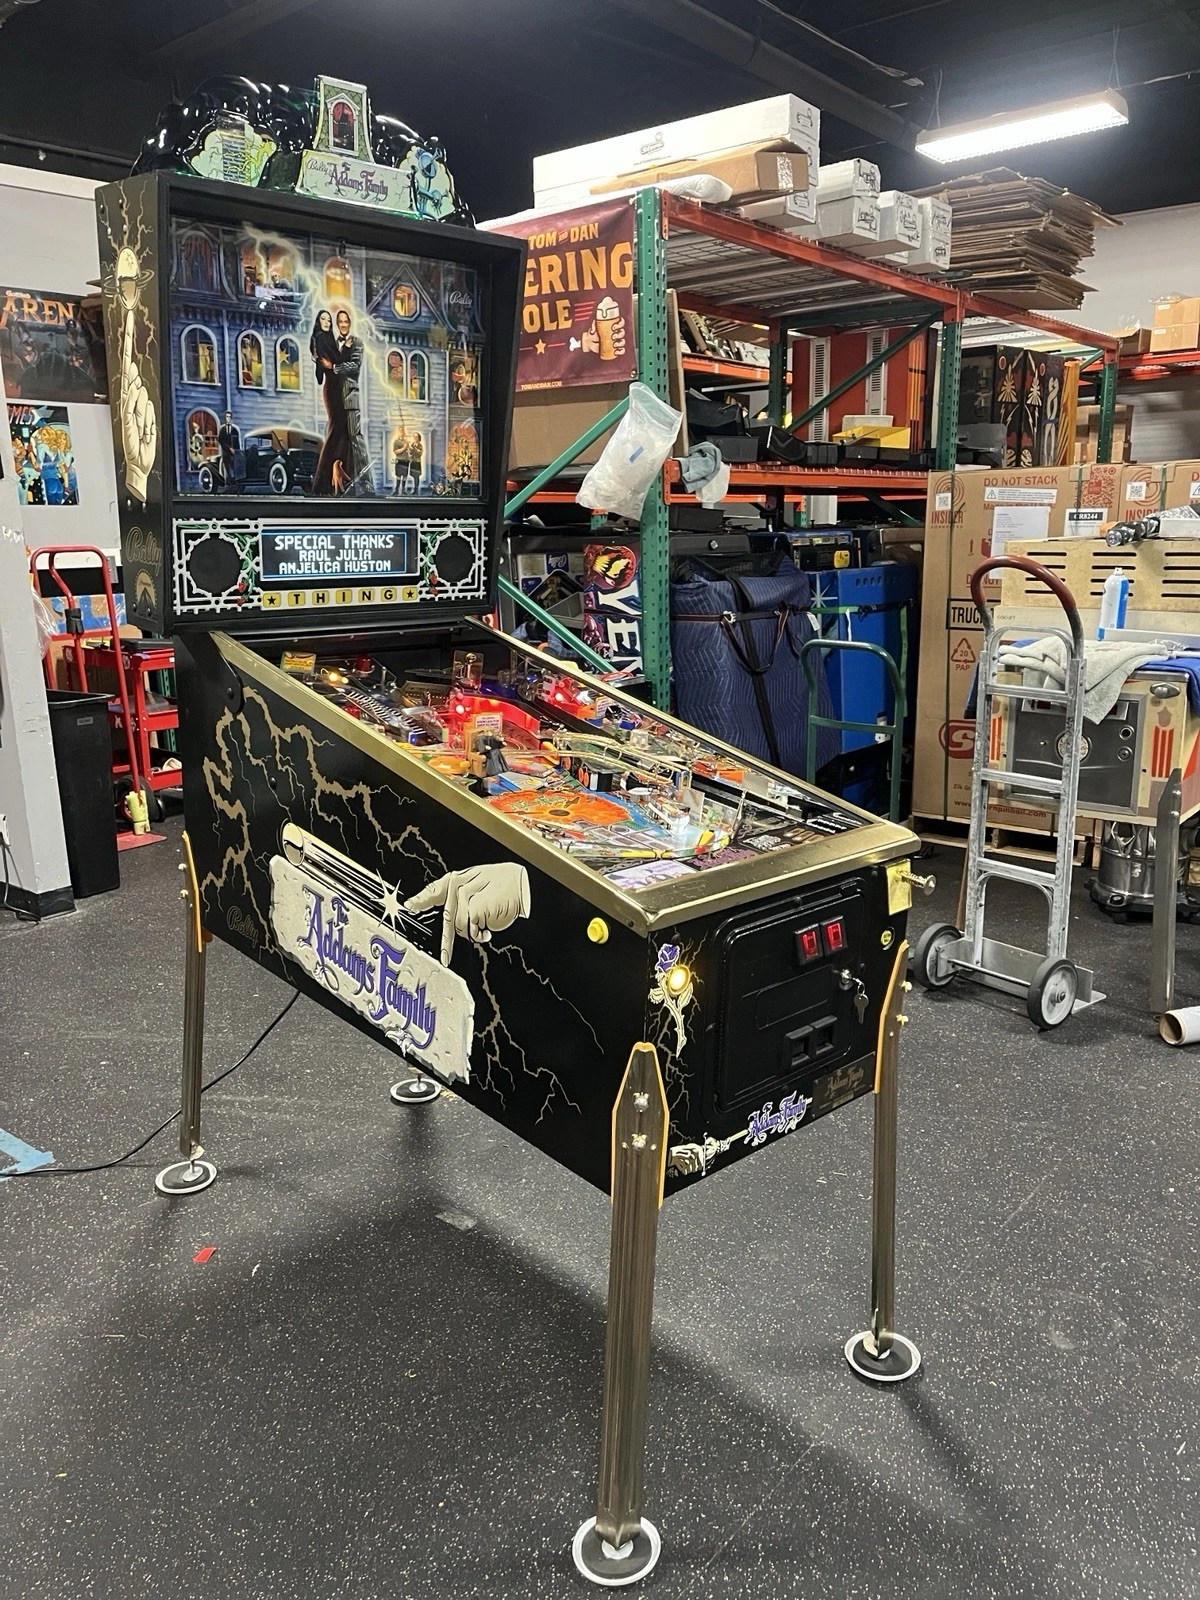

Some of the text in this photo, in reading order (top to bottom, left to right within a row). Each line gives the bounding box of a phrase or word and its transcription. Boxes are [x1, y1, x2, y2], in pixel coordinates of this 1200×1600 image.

[528, 231, 558, 250] TOM
[570, 223, 599, 243] DAN
[524, 242, 633, 298] ERING
[450, 291, 473, 308] Bally
[984, 475, 1058, 487] DO NOT STACK
[126, 526, 162, 576] Bally
[275, 535, 394, 550] SPECIAL THANKS
[299, 549, 371, 561] RAUL JULIA
[279, 560, 391, 574] ANJELICA HUSTON
[951, 606, 983, 624] TRUC
[226, 905, 258, 949] Bally
[297, 884, 375, 995] Addams
[368, 934, 436, 1050] Family
[778, 1090, 807, 1134] Family
